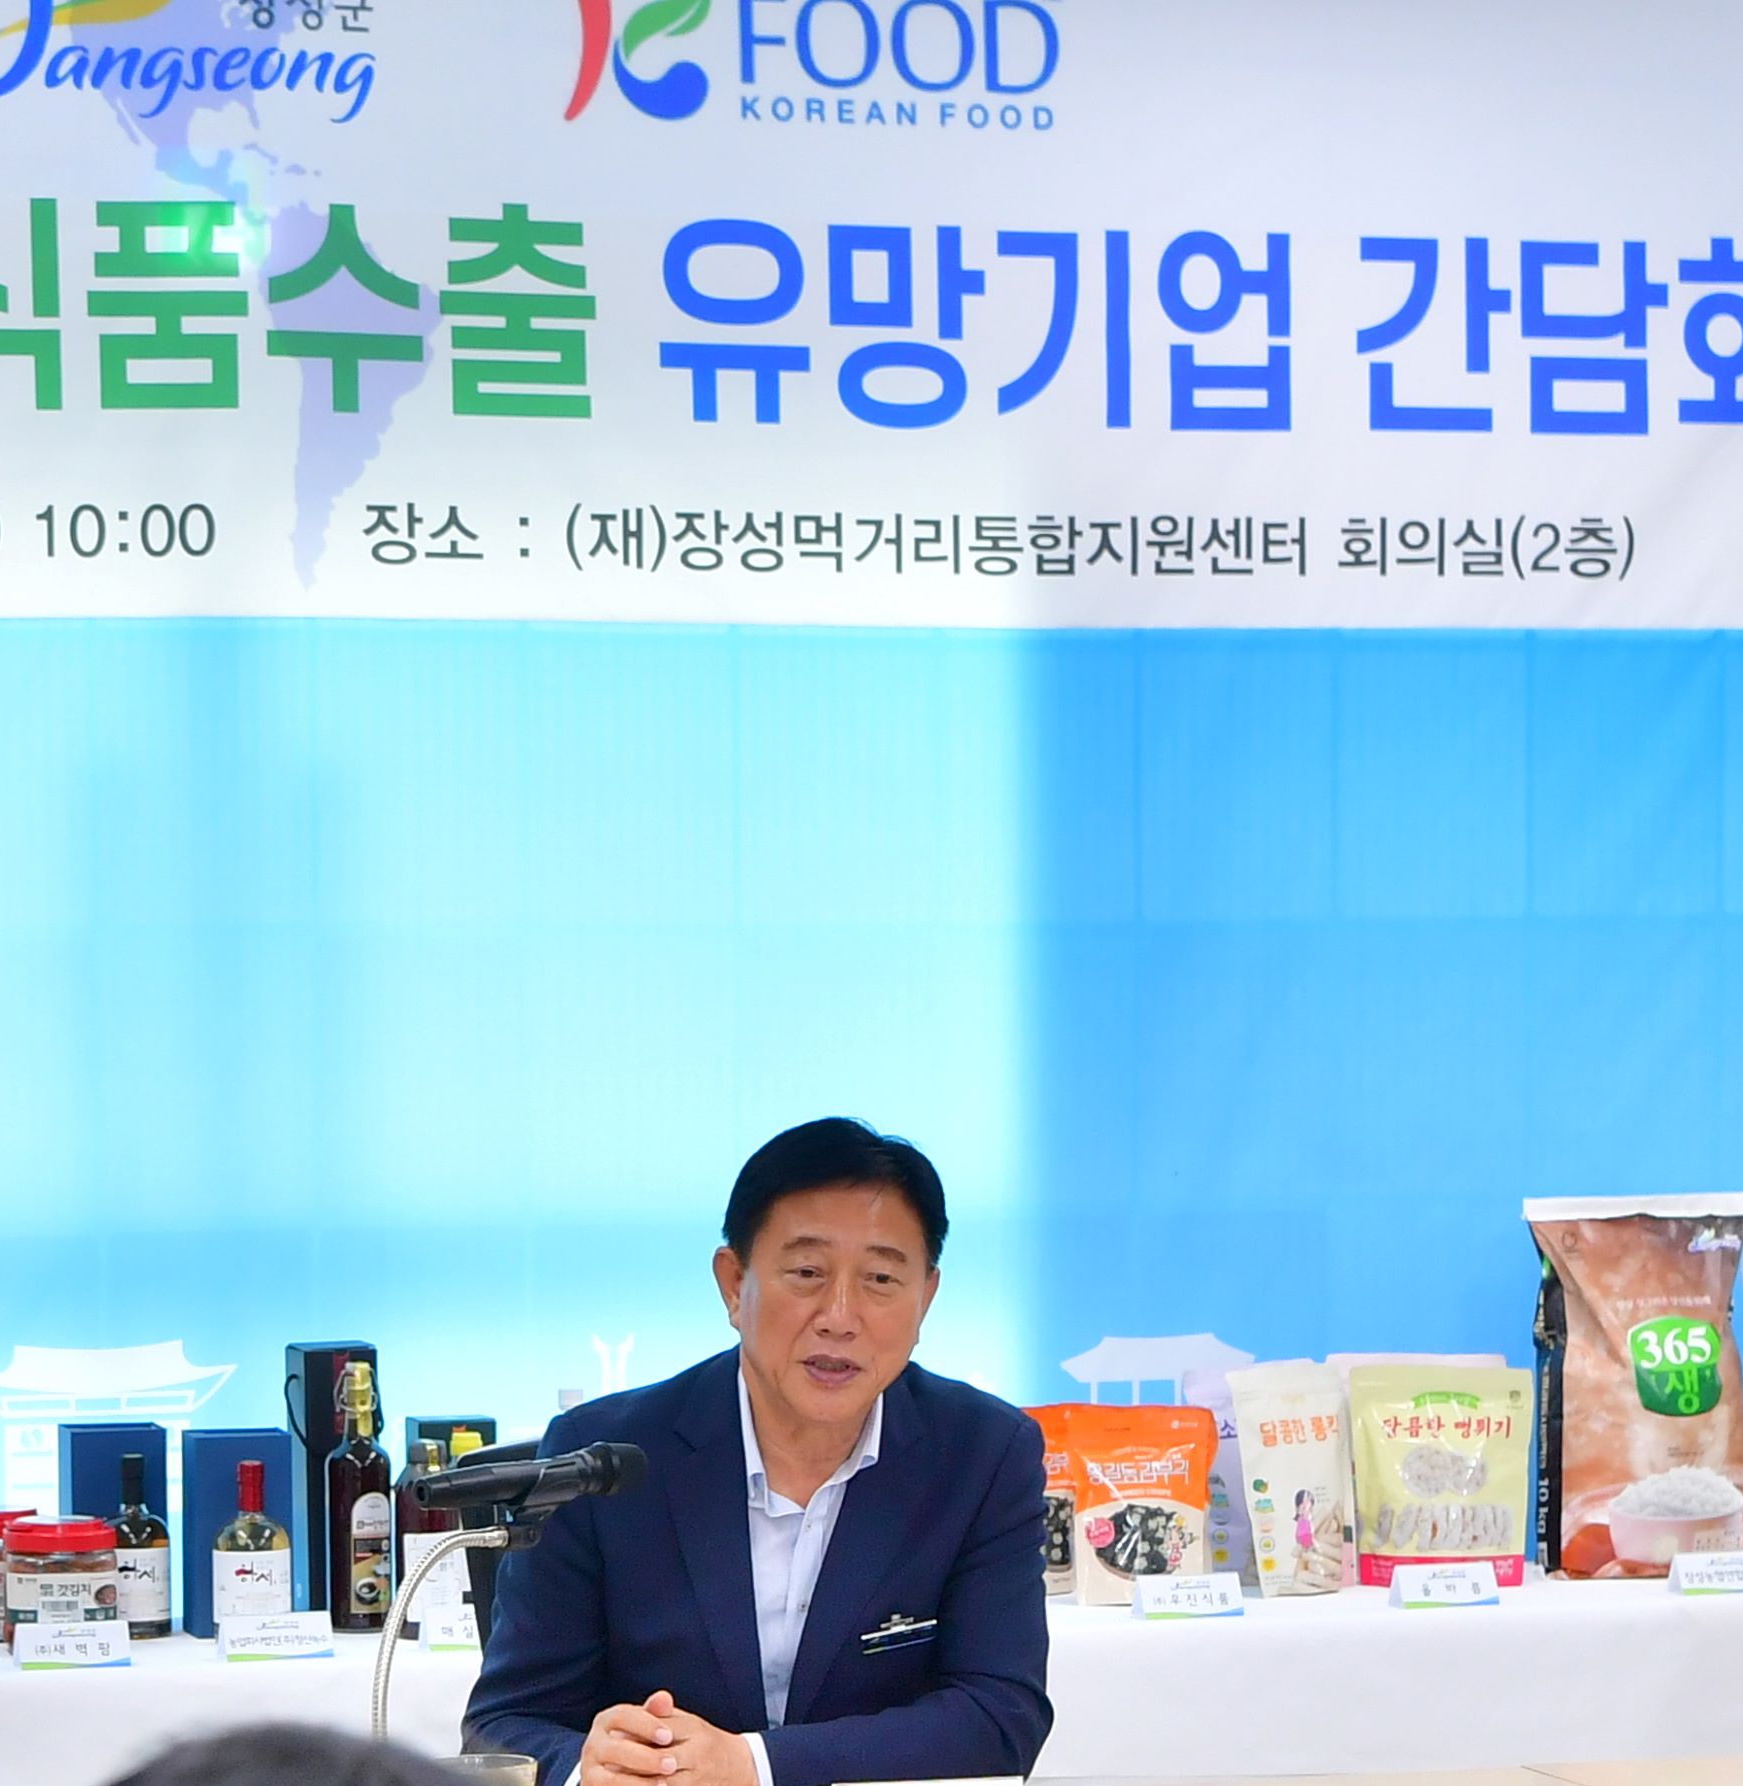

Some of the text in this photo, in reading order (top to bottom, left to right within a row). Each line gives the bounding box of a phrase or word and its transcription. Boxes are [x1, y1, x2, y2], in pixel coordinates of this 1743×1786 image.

[739, 0, 1060, 94] FOOD
[741, 96, 1054, 130] KOREAN FOOD
[659, 218, 1292, 431] 유망기업
[35, 502, 216, 559] 10:00
[362, 501, 484, 565] 장소
[564, 502, 1307, 577] (재)장성먹거리통합지원센터
[1337, 514, 1636, 582] 회의실(2층)
[1636, 1326, 1711, 1369] 365
[1664, 1368, 1699, 1414] 생
